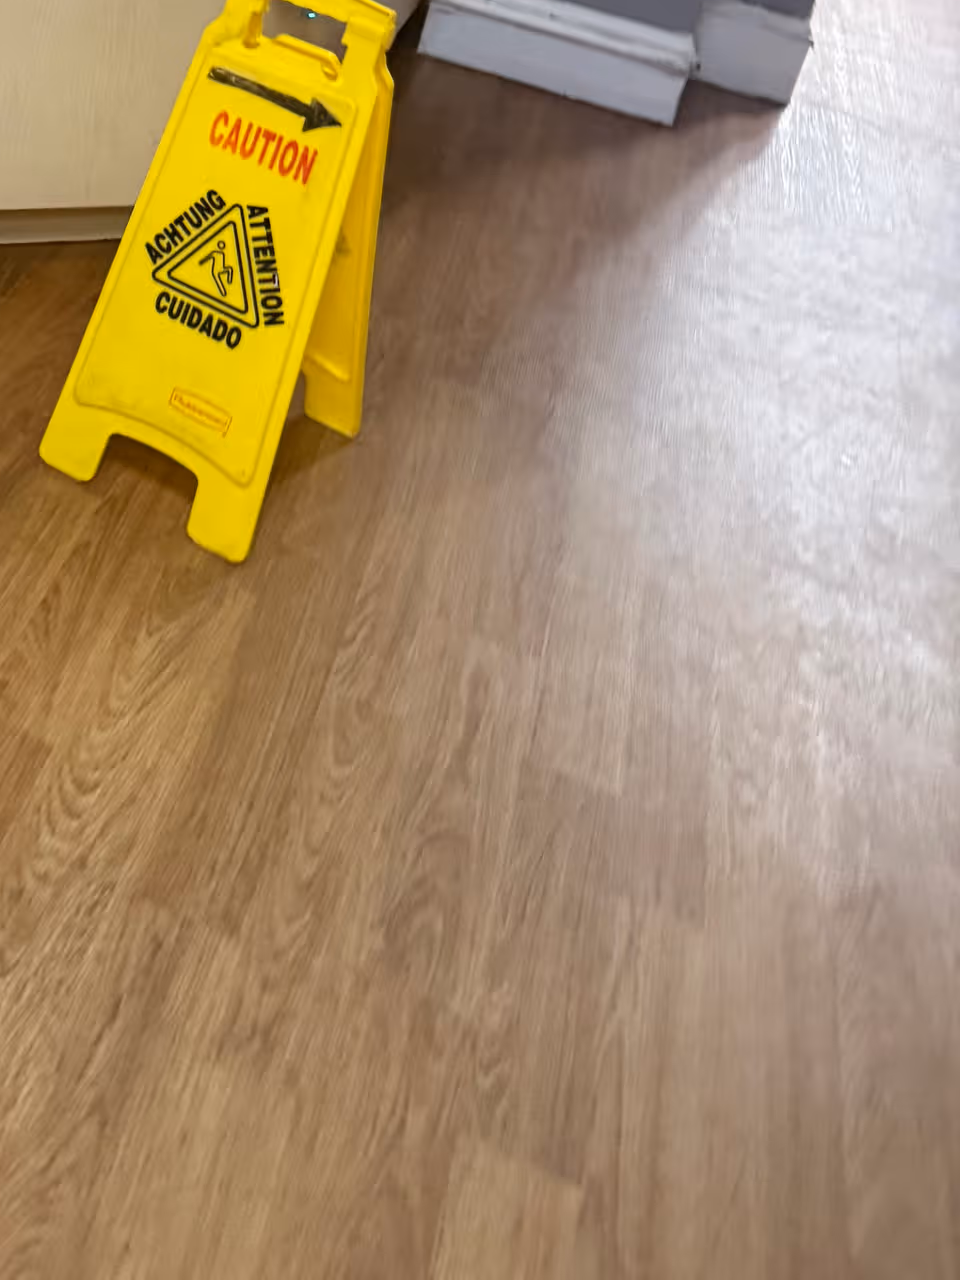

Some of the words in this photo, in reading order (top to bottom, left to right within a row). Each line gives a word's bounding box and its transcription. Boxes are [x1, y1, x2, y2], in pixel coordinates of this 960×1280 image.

[209, 110, 318, 186] CAUTION
[144, 189, 226, 265] ACHTUNG
[246, 205, 285, 326] ATTENTION
[155, 291, 242, 350] CUIDADO
